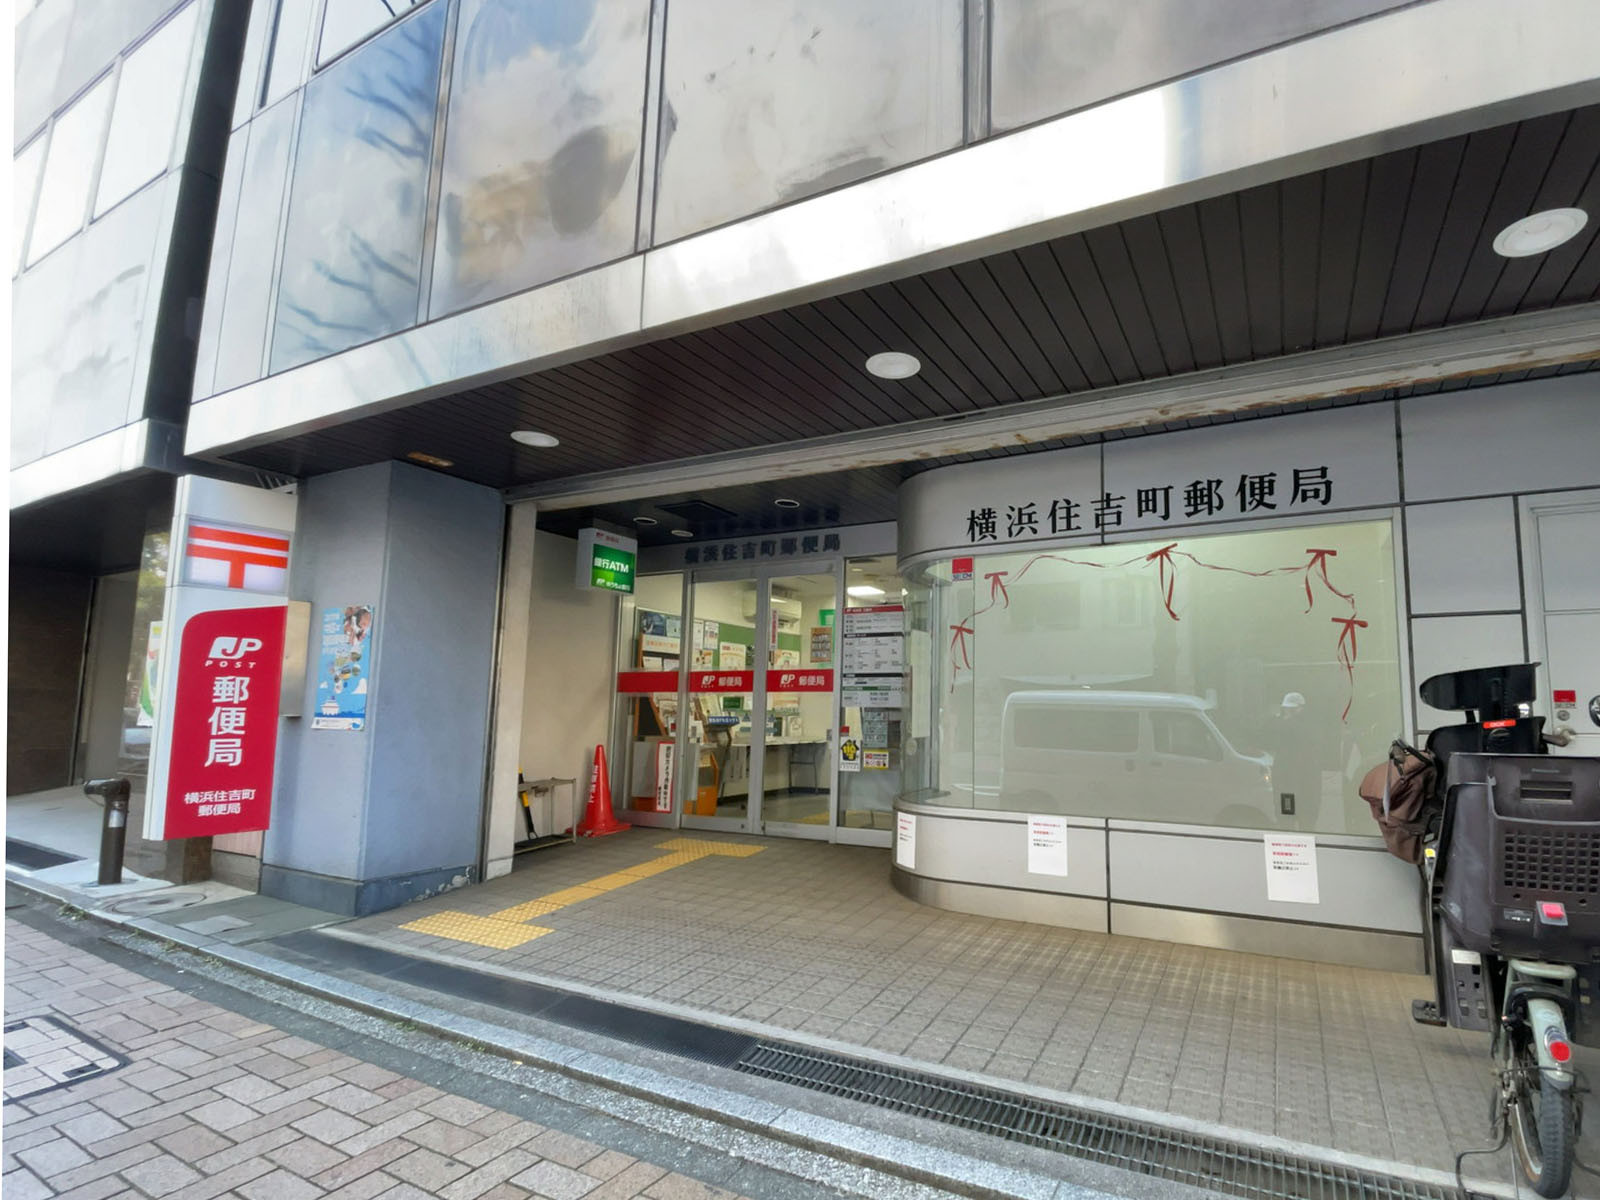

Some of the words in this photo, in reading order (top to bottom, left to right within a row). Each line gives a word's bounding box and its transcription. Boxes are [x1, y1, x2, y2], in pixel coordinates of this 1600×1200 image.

[966, 466, 1335, 542] 横浜住吉町郵便局
[685, 533, 840, 563] 横浜住吉町郵便局
[594, 557, 629, 573] 銀行ATM
[205, 660, 257, 669] POST
[718, 676, 742, 687] 郵便局
[798, 675, 825, 686] 郵便局
[204, 675, 250, 767] 郵便局
[184, 788, 256, 804] 横浜住吉町
[197, 802, 241, 817] 郵便局
